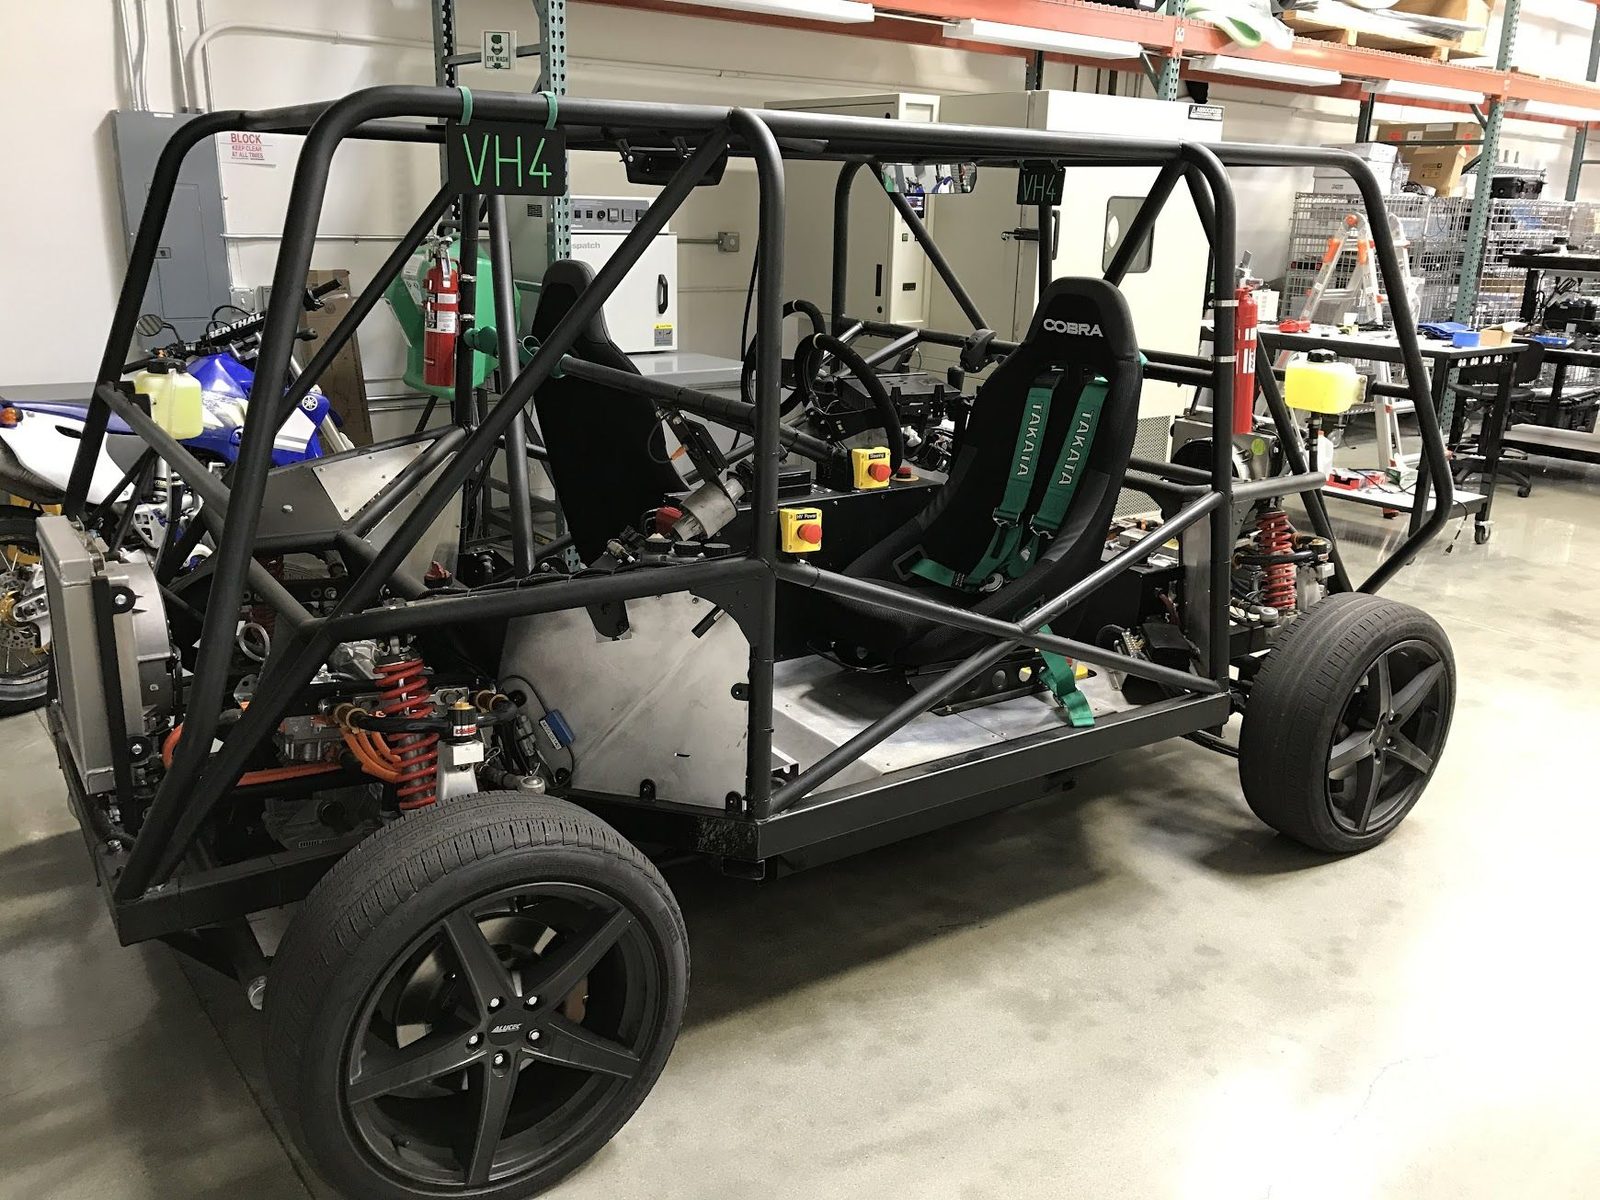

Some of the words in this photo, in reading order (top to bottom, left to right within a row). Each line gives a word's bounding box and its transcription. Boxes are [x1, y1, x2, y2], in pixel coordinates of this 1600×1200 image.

[231, 133, 262, 144] BLOCK
[462, 133, 552, 189] VH4
[1023, 174, 1057, 202] VH4
[572, 241, 601, 251] spatch
[1043, 318, 1104, 338] COBRA
[1017, 402, 1044, 476] TAKATA
[1059, 411, 1095, 485] TAKATA
